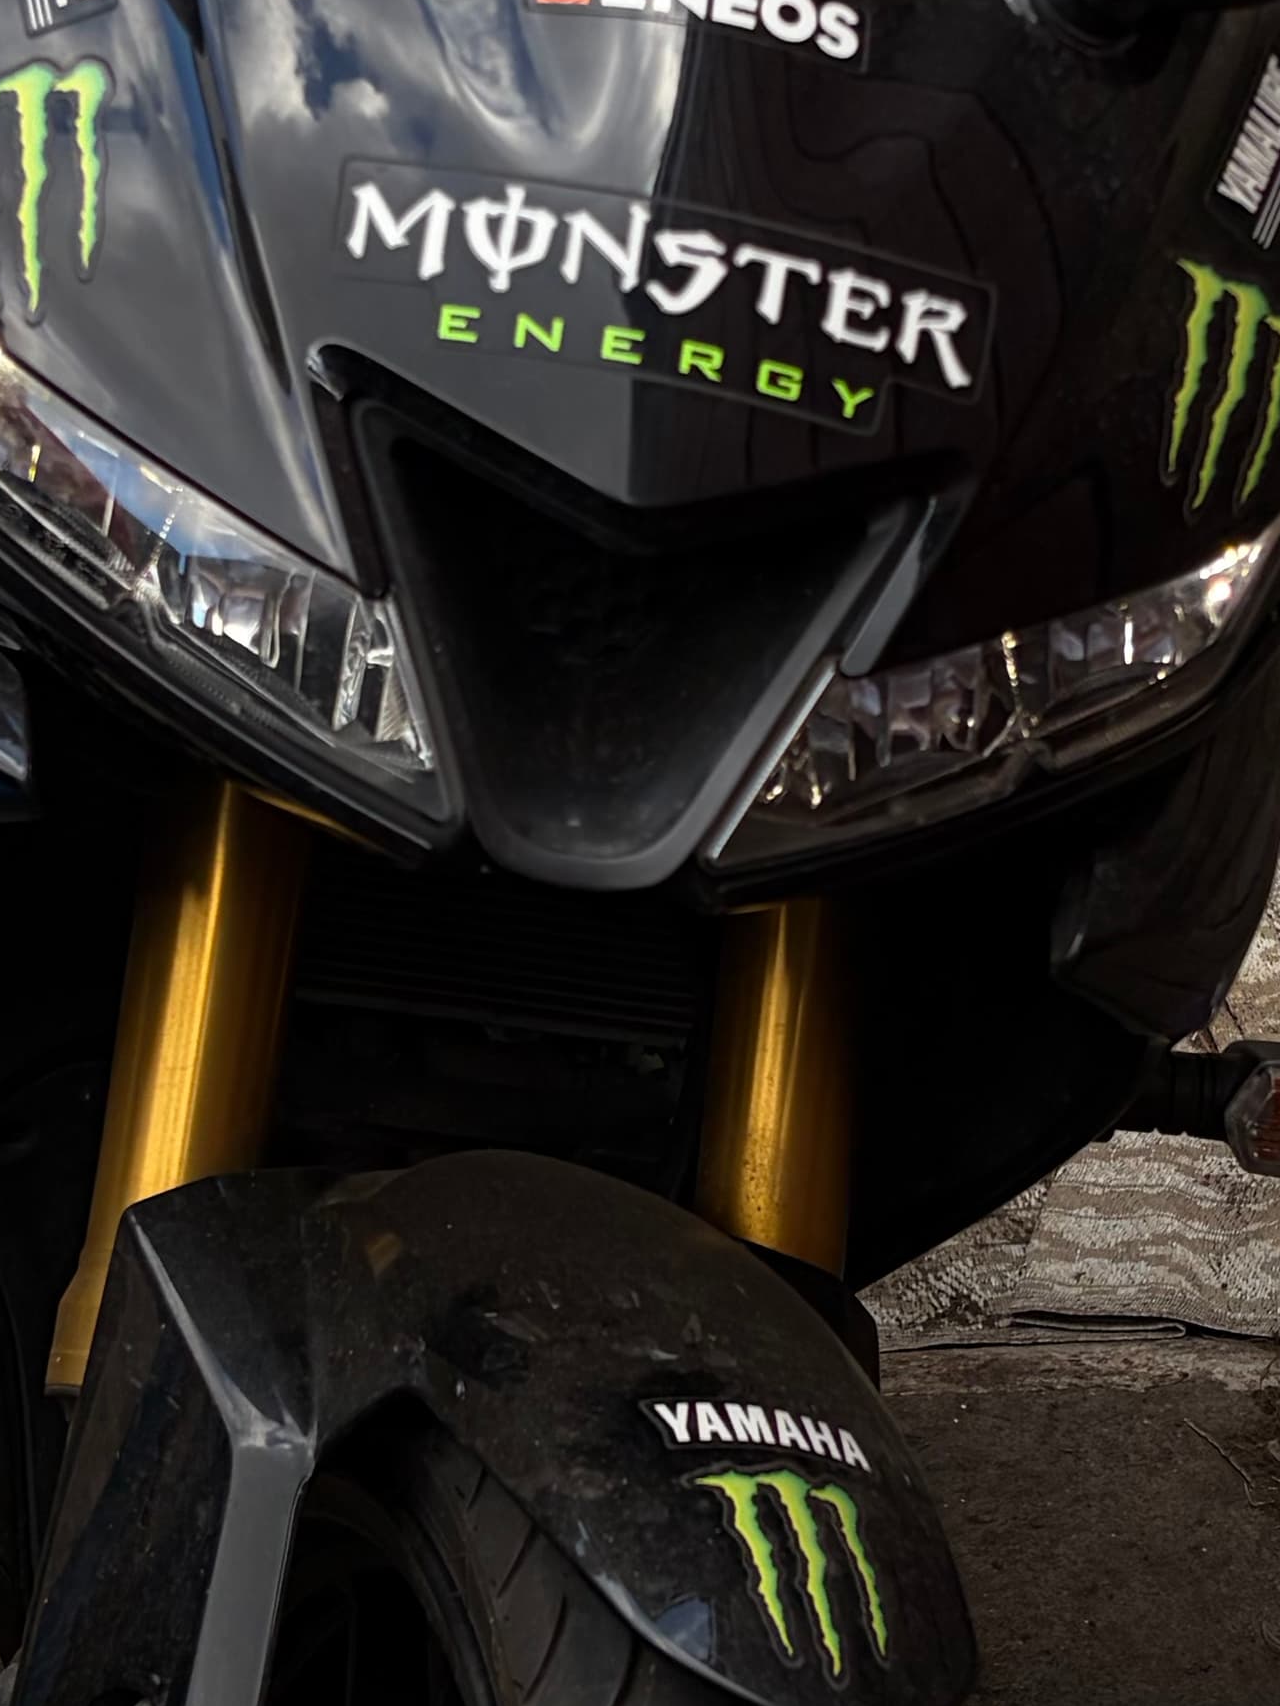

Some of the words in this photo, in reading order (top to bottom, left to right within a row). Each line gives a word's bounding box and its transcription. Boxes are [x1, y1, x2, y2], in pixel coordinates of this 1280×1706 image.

[345, 180, 971, 389] MONSTER
[437, 301, 875, 420] ENERGY
[654, 1402, 871, 1470] YAMAHA
